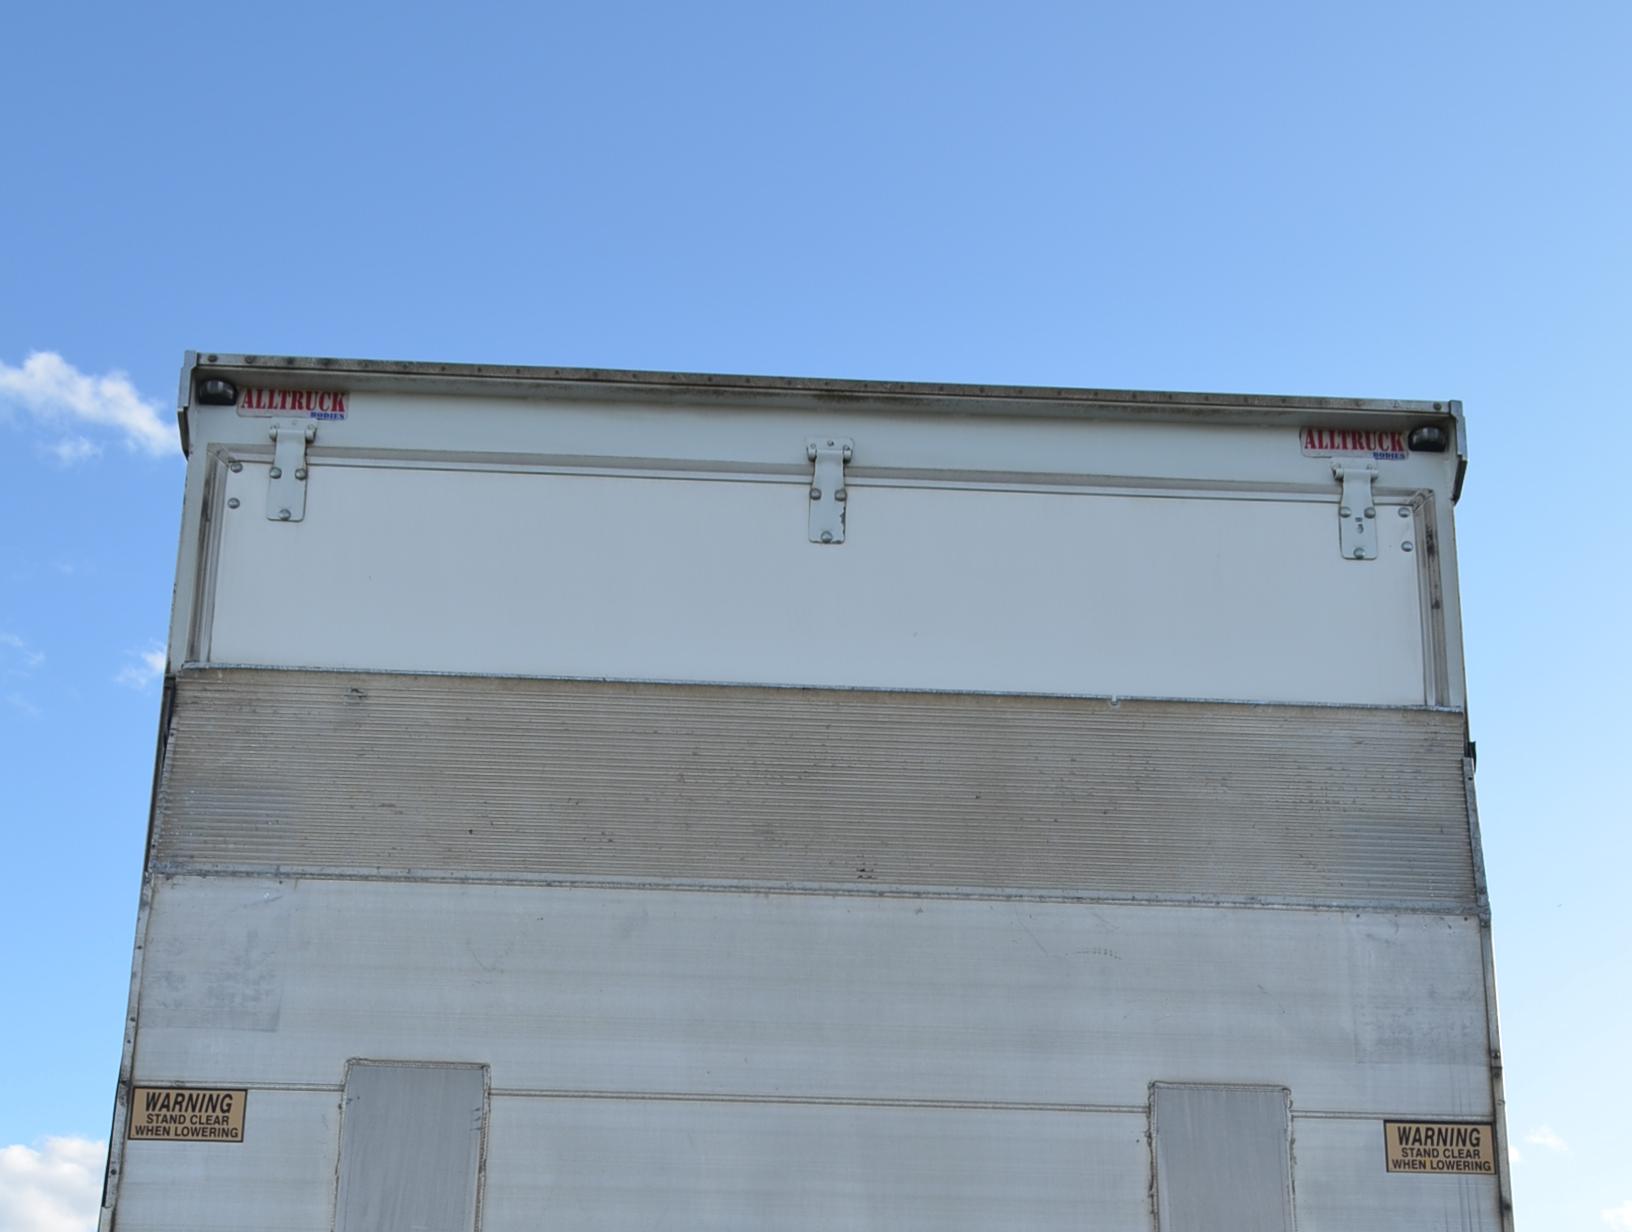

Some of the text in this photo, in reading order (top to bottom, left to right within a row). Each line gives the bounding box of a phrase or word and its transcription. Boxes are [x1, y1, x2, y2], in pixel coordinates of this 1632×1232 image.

[241, 387, 345, 412] ALLTRUCK
[1304, 428, 1404, 452] ALLTRUCK
[145, 1092, 233, 1114] WARNING
[146, 1113, 229, 1126] STAND CLEAR
[135, 1125, 238, 1138] WHEN LOWERING
[1397, 1126, 1481, 1148] WARNING
[1401, 1147, 1480, 1160] STAND CLEAR
[1392, 1159, 1491, 1172] WHEN LOWERING
